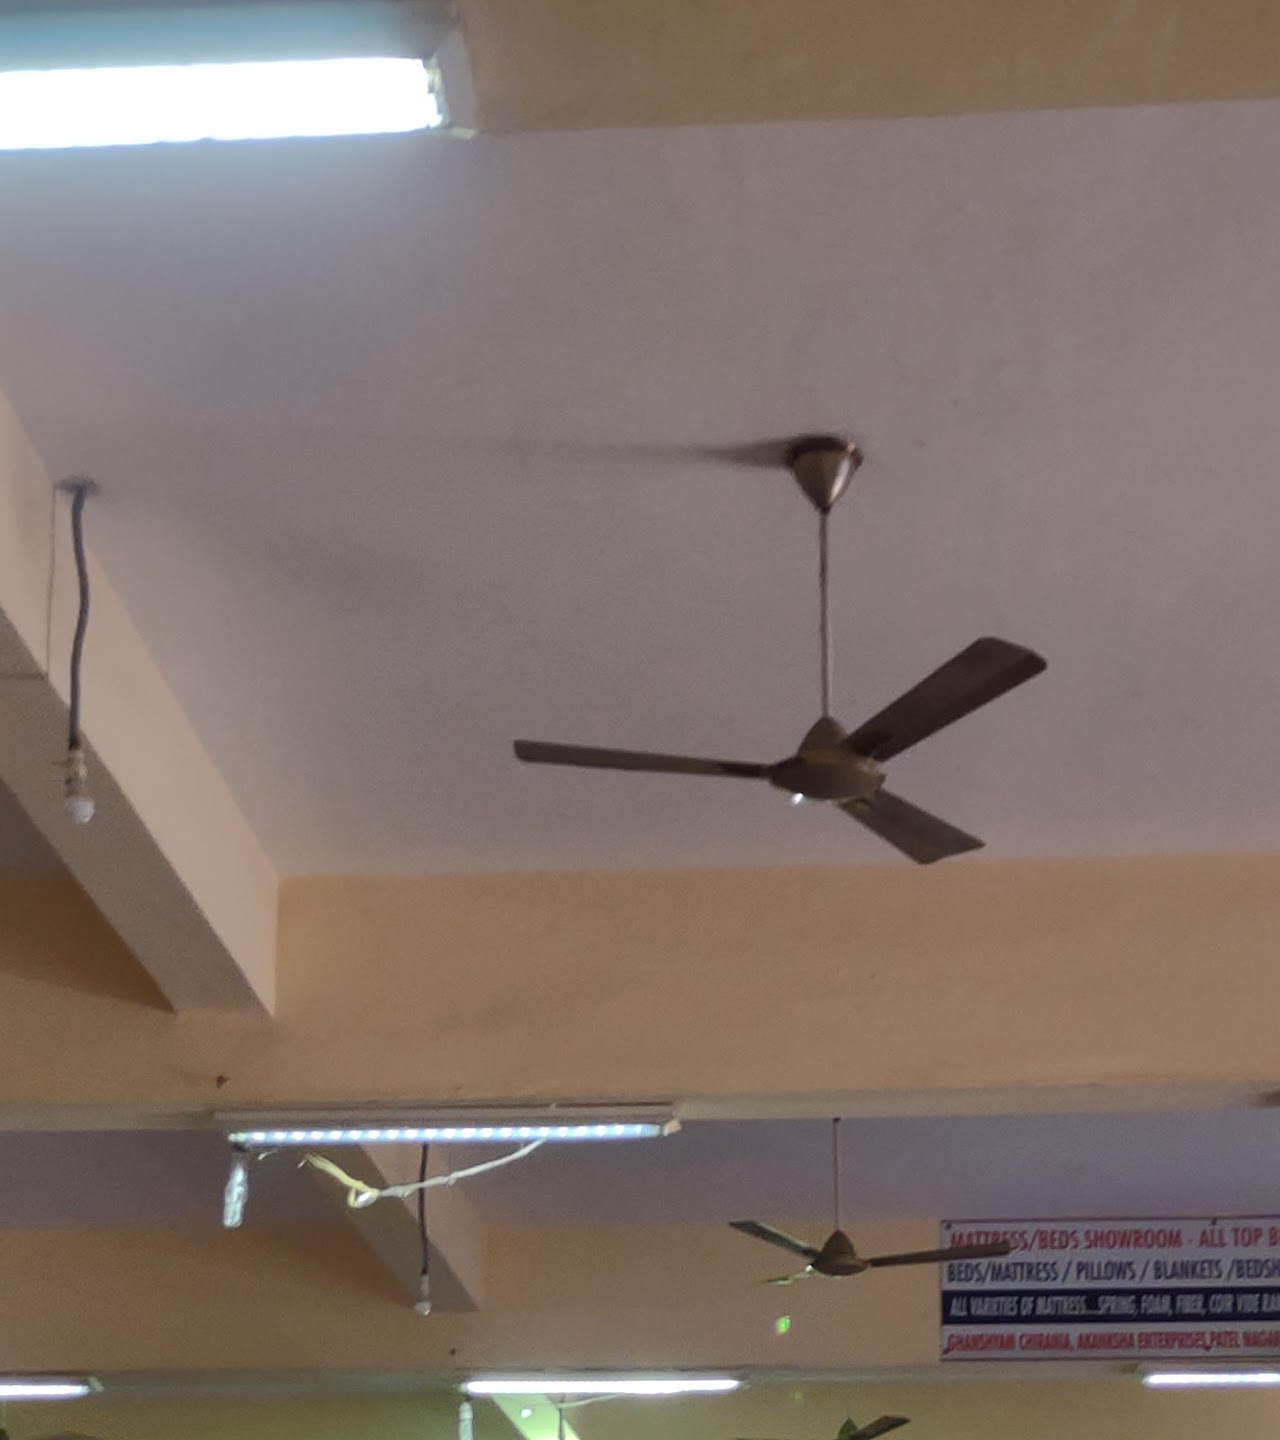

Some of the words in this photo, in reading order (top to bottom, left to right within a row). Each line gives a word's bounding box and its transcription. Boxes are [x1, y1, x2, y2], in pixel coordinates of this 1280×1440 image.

[950, 1229, 1079, 1251] MATTRESS/BEDS
[1083, 1229, 1183, 1250] SHOWROOM
[1198, 1228, 1227, 1248] ALL
[1231, 1226, 1263, 1248] TOP
[947, 1260, 1059, 1283] BEDS/MATTRESS
[1076, 1259, 1136, 1281] PILLOWS
[1153, 1258, 1223, 1281] BLANKETS
[950, 1296, 968, 1316] ALL
